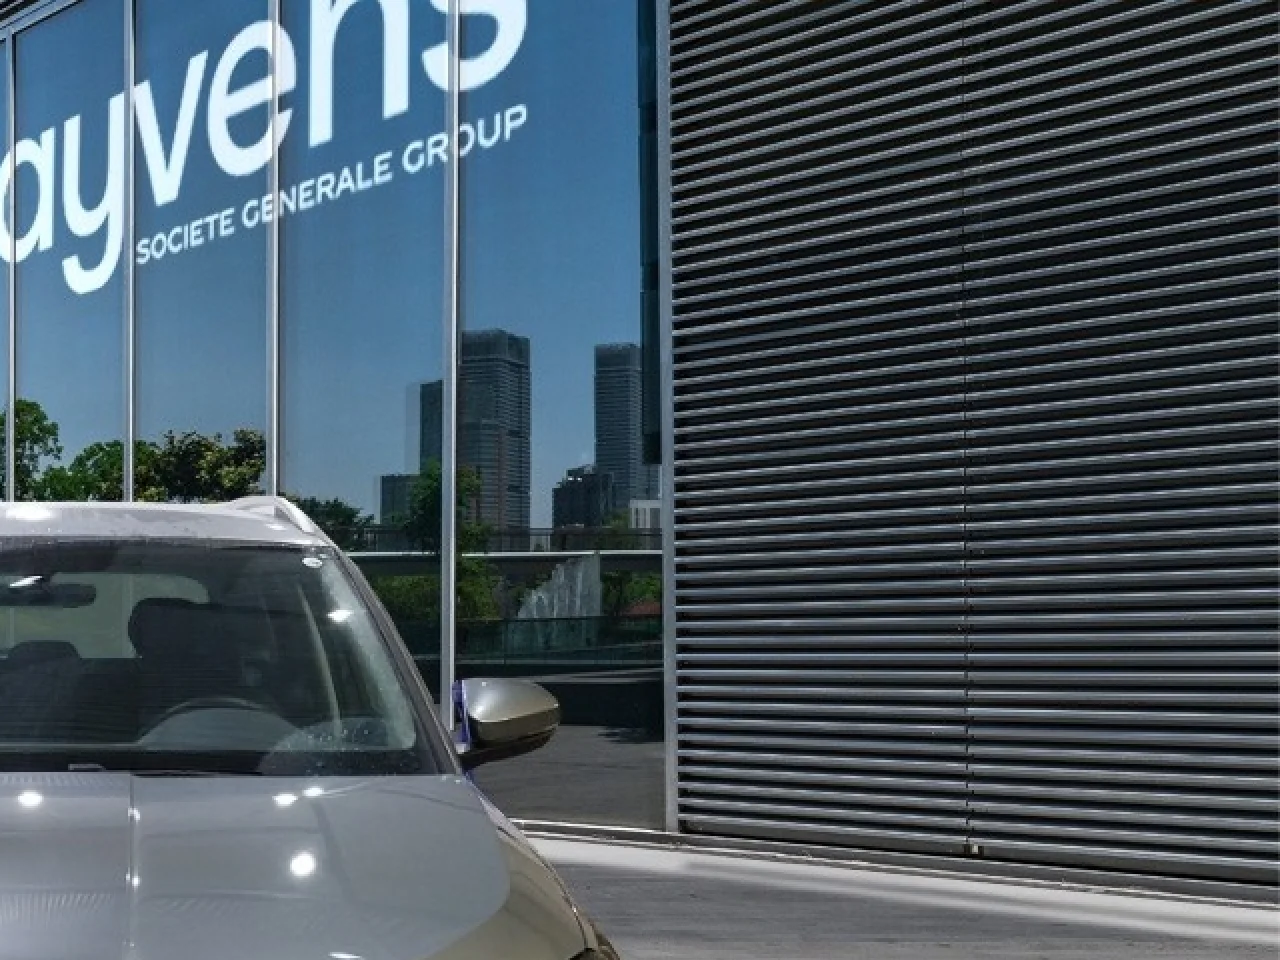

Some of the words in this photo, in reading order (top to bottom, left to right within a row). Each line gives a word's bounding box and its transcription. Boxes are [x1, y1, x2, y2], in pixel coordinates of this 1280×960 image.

[136, 207, 235, 265] SOCIETE
[242, 151, 393, 229] GENERALE
[402, 104, 528, 173] GROUP
